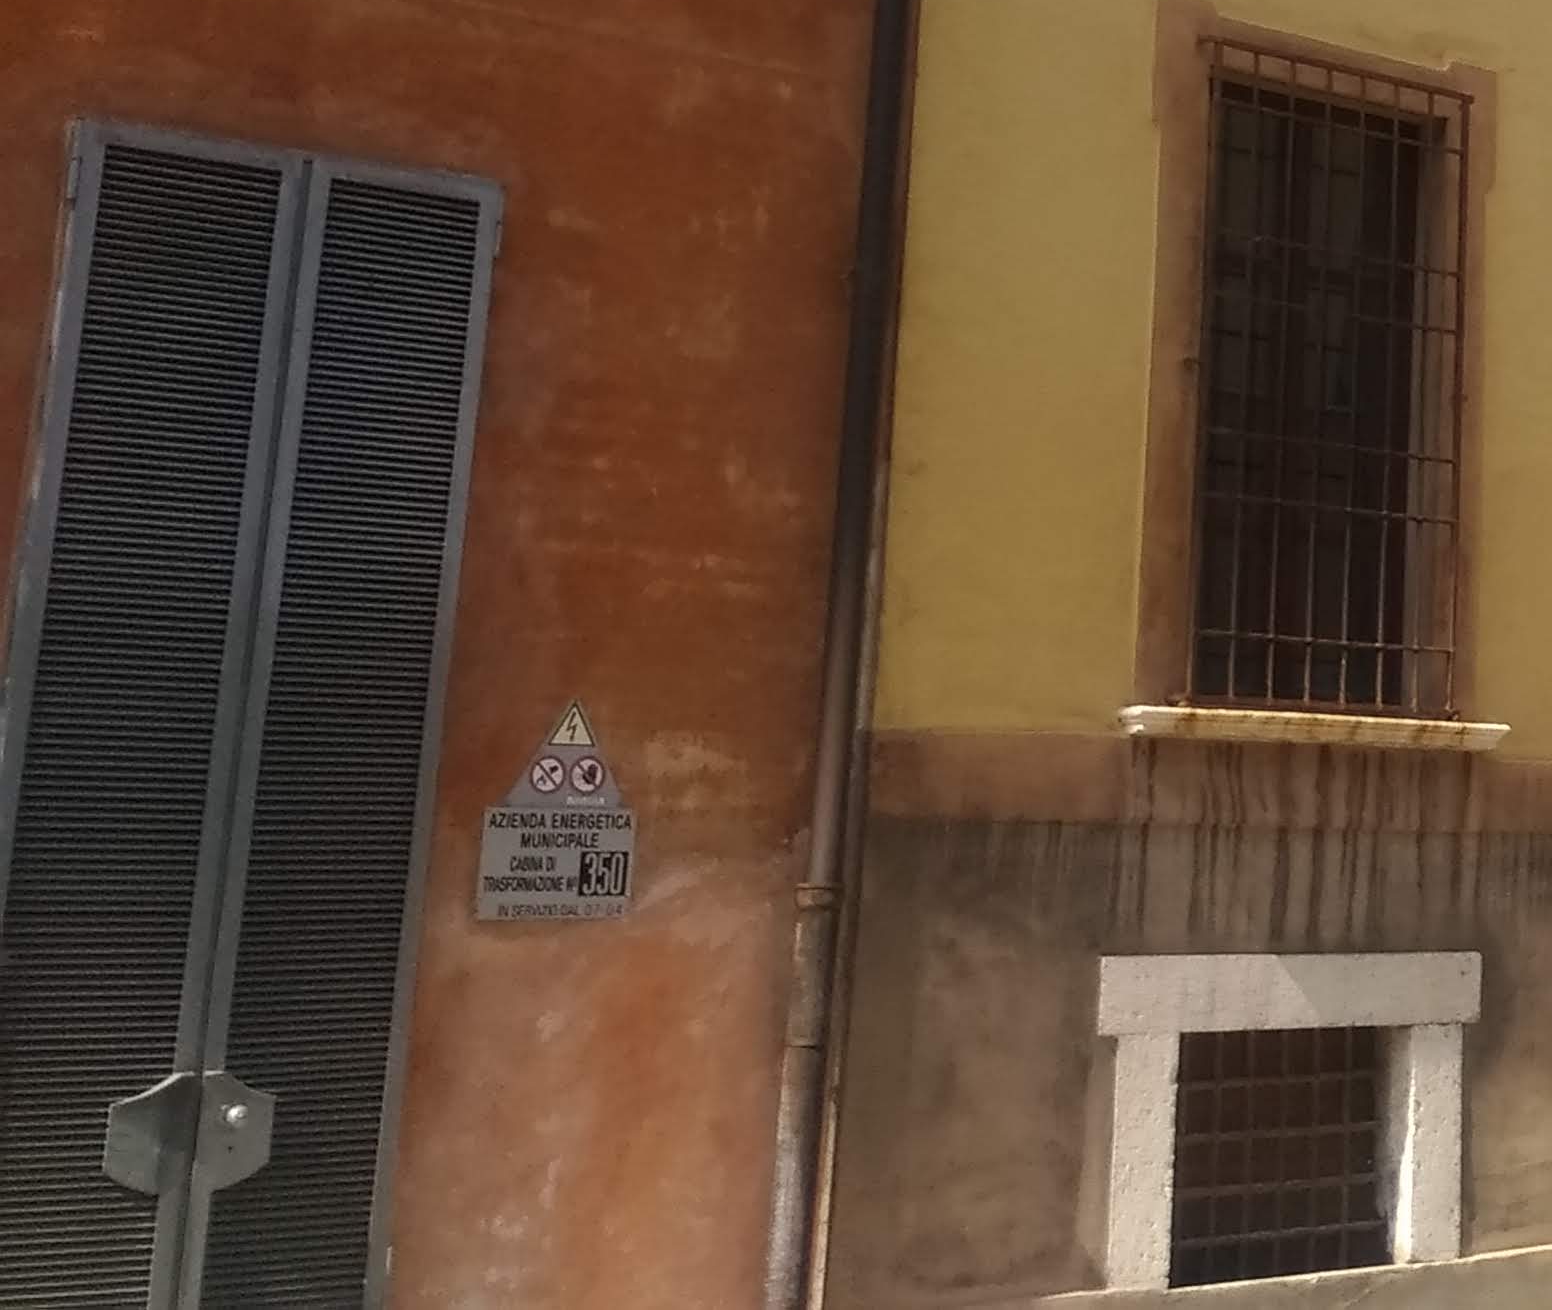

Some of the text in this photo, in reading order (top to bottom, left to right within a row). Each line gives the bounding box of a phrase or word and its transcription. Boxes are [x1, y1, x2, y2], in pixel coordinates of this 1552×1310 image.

[489, 813, 632, 830] AZIENDA ENERGETICA
[520, 833, 600, 849] MUNICIPALE
[510, 856, 557, 871] CABINA DI
[582, 852, 625, 895] 350
[483, 876, 564, 892] TRASFORMAZIONE
[498, 903, 509, 917] IN
